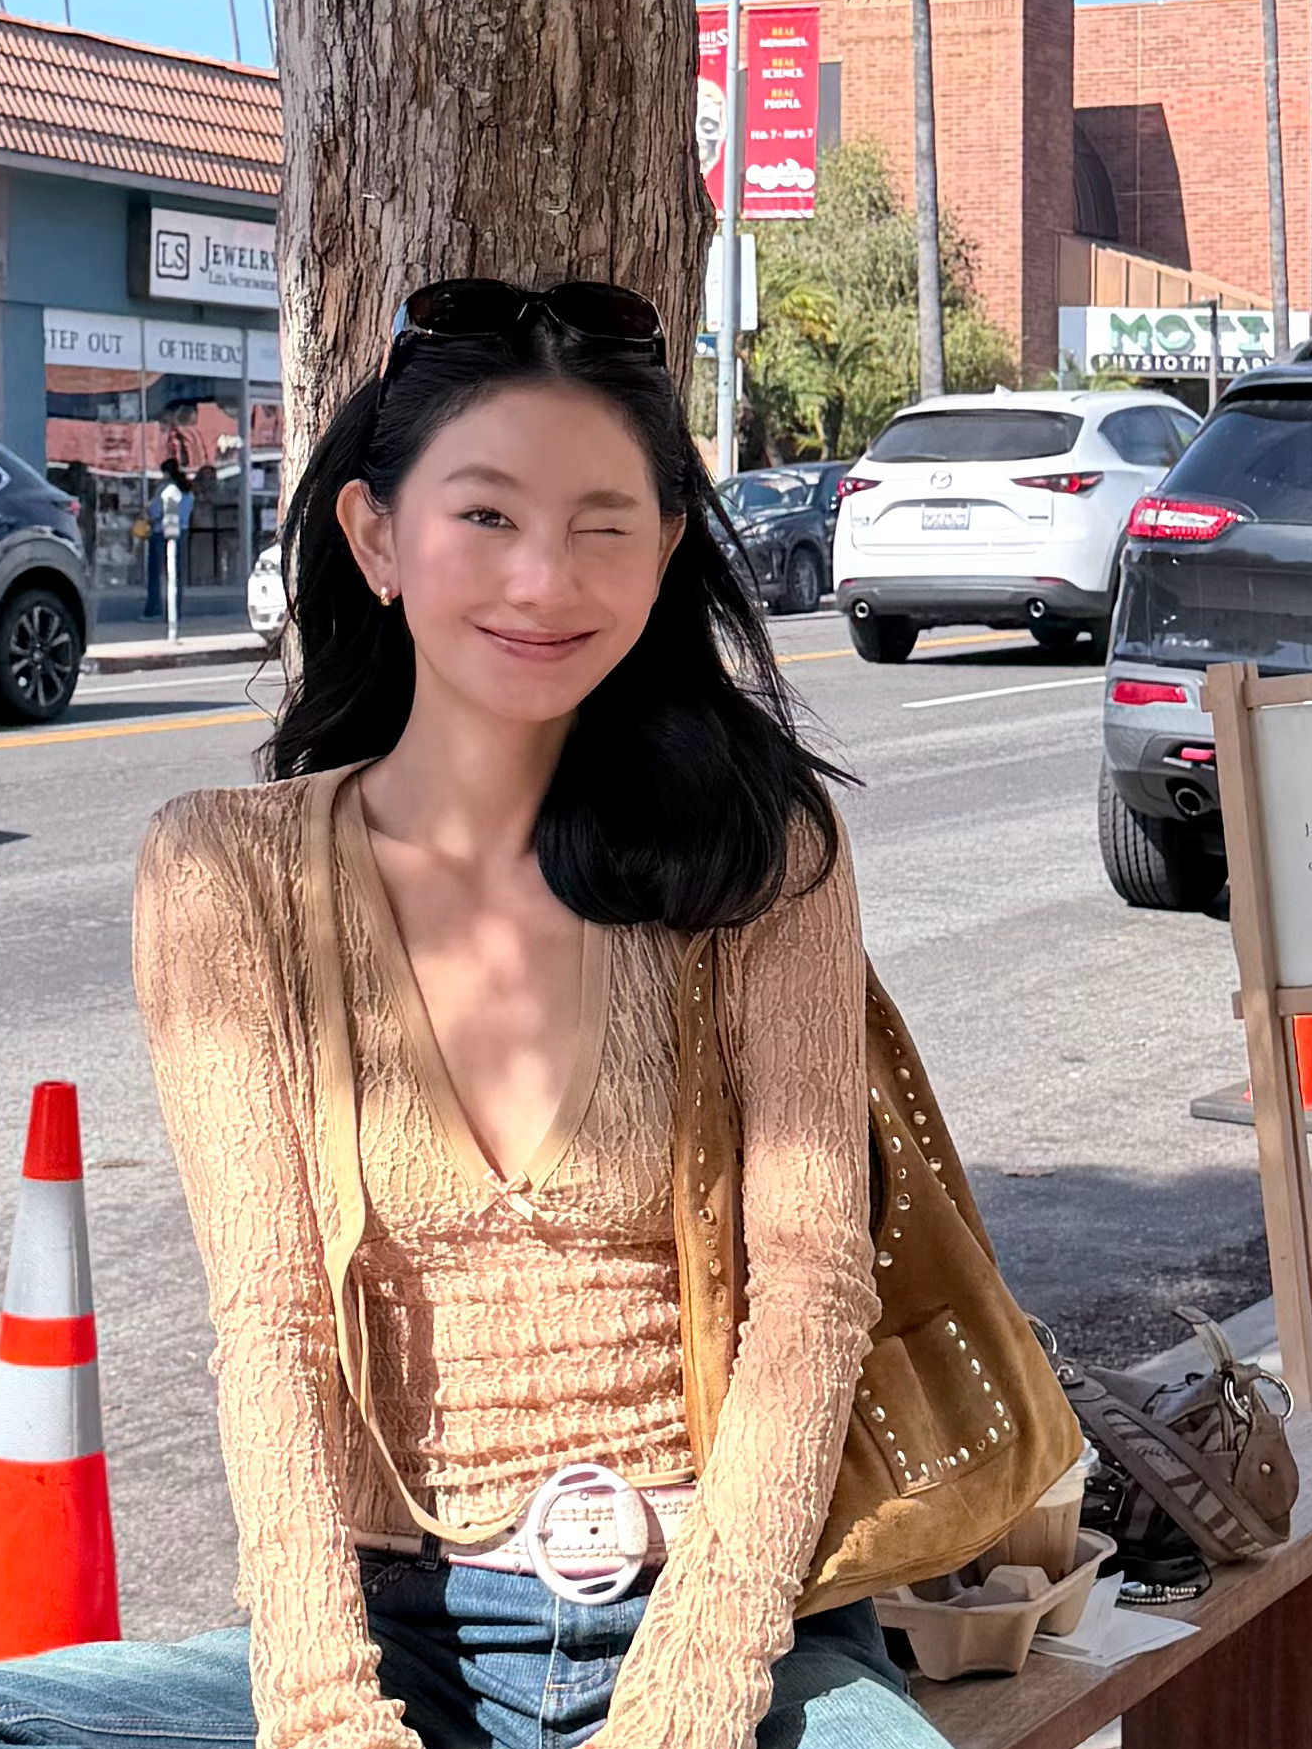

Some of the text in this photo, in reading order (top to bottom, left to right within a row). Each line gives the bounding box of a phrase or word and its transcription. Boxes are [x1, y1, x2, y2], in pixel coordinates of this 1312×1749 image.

[161, 242, 186, 270] LS
[89, 332, 124, 355] OUT
[1110, 312, 1270, 357] MOTI
[158, 338, 176, 359] OF
[179, 341, 207, 362] THE
